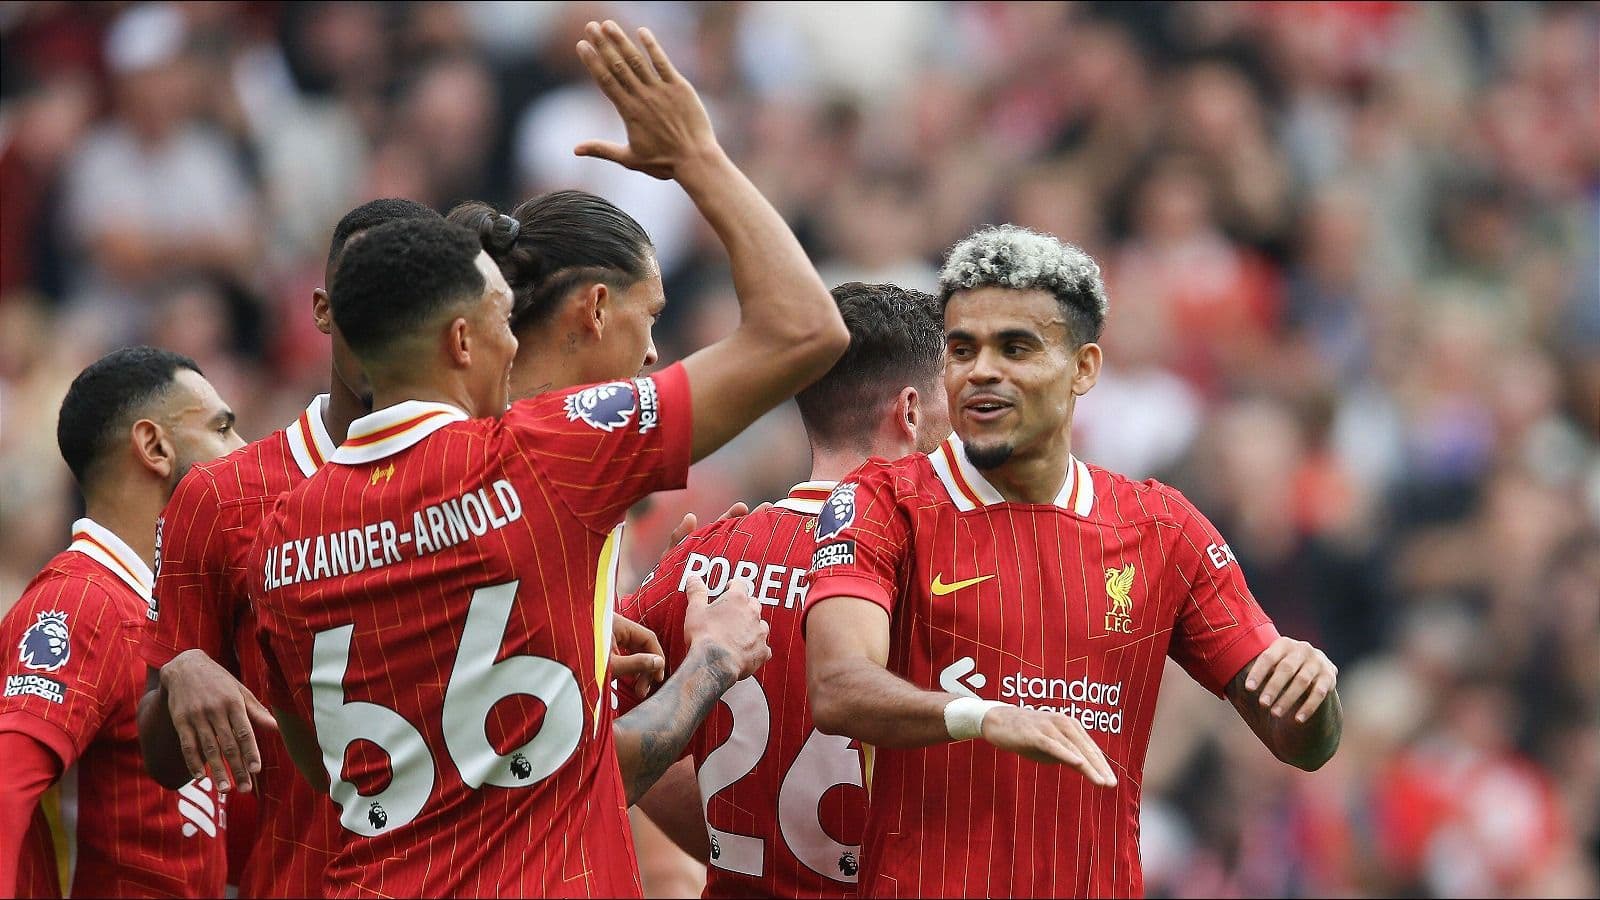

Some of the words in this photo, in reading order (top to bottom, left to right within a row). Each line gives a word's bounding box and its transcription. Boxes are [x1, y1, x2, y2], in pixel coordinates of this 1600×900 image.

[264, 479, 522, 592] ALEXANDER-ARNOLD
[817, 543, 848, 559] room
[1206, 543, 1237, 569] Ex
[817, 554, 854, 571] racism
[7, 675, 24, 687] No
[24, 675, 60, 693] room
[22, 685, 64, 704] racism
[1001, 671, 1122, 706] standard
[310, 579, 584, 837] 66
